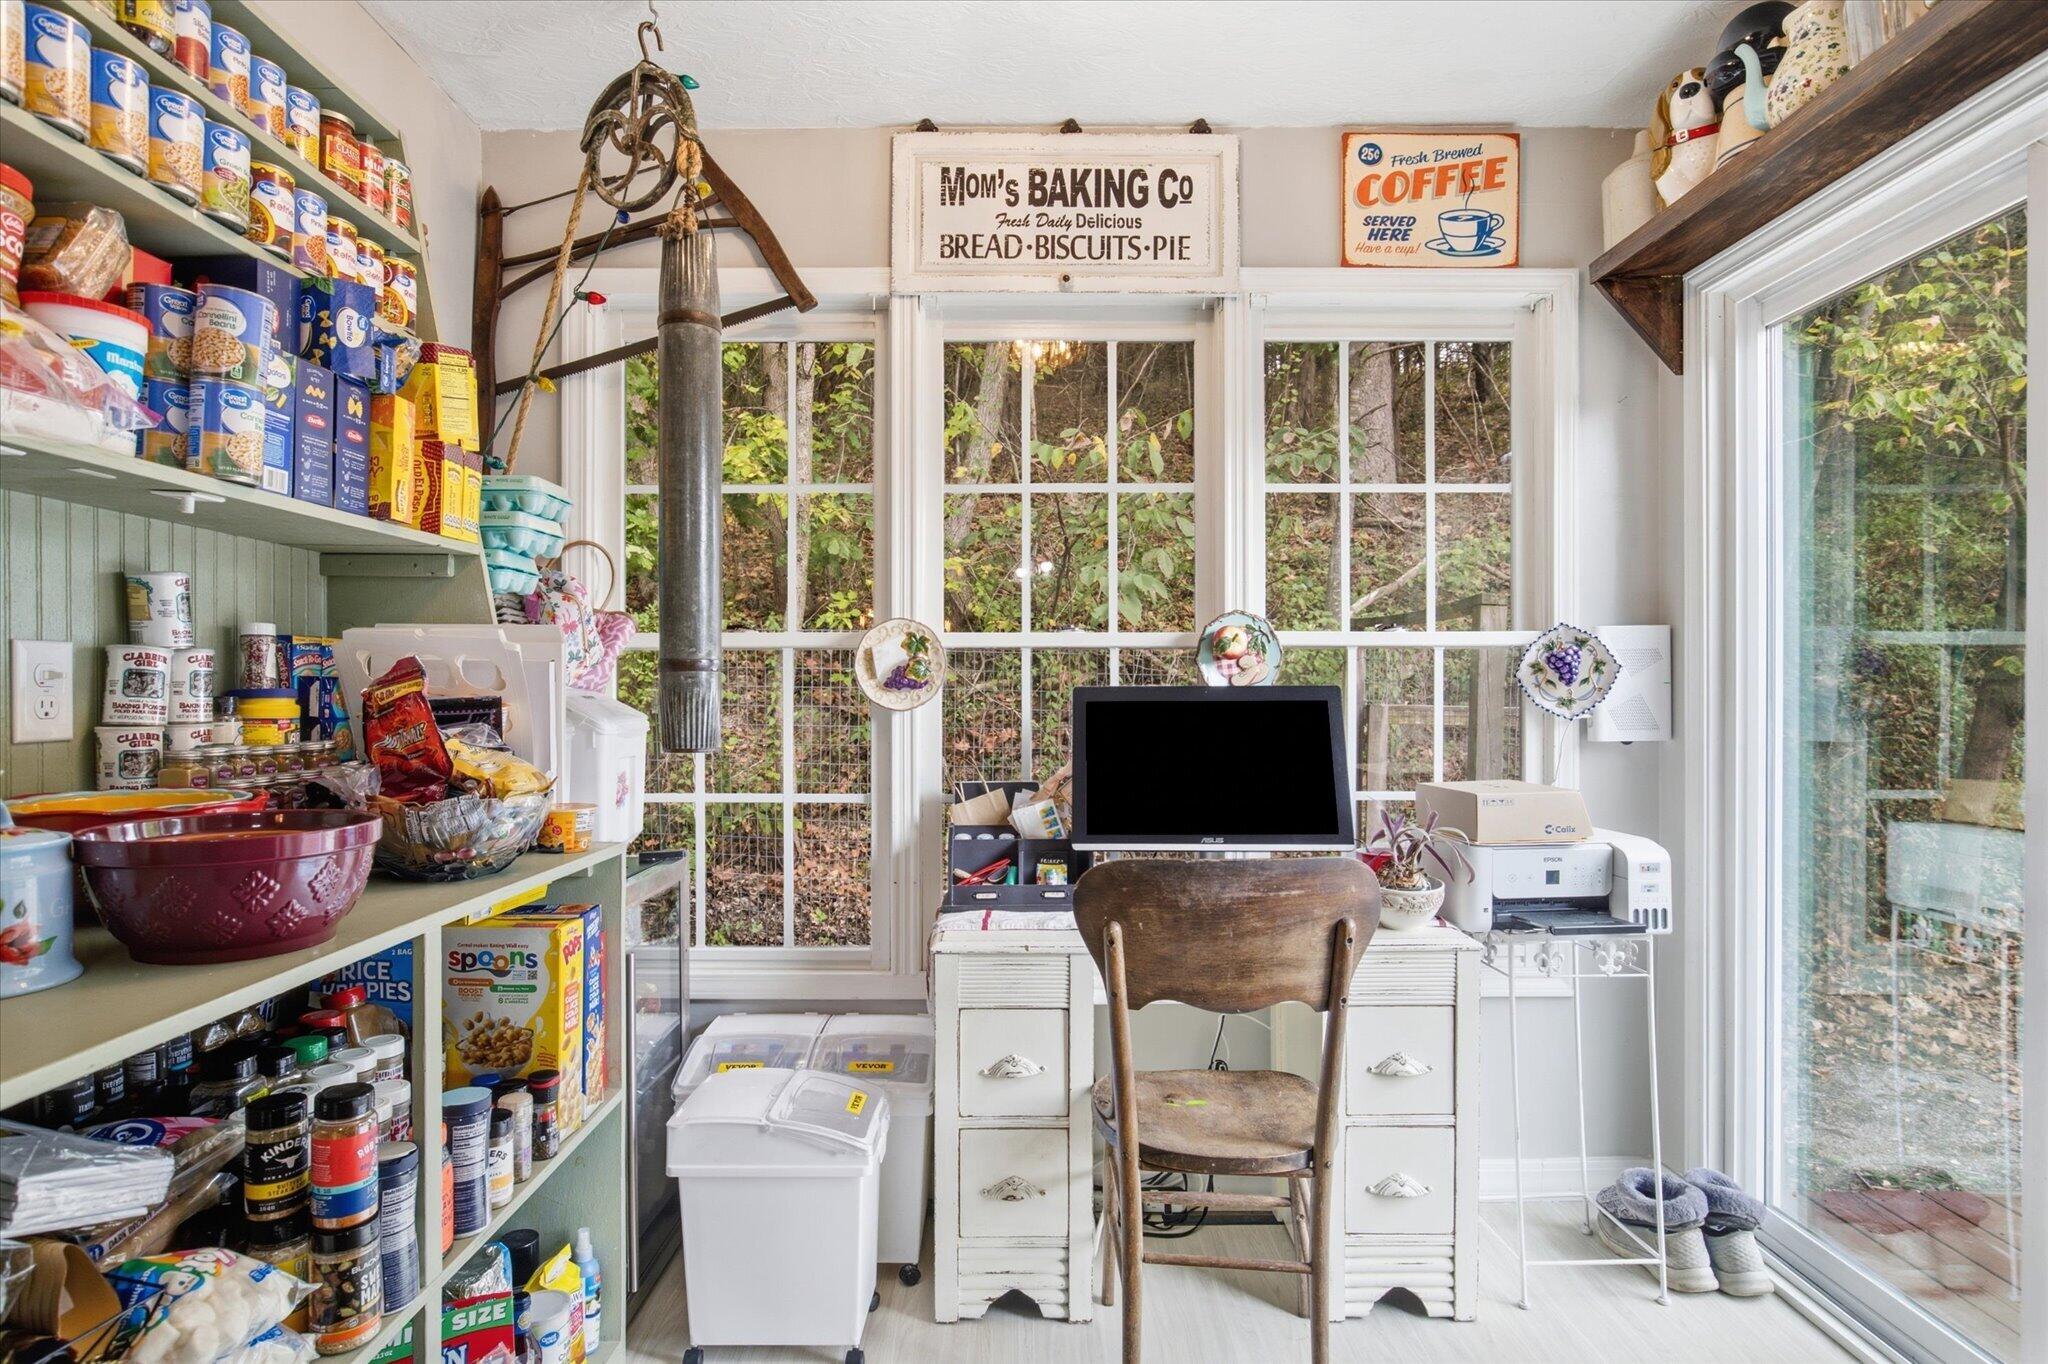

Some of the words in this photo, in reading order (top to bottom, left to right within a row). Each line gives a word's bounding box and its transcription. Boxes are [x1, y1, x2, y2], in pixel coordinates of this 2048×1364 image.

[1390, 152, 1430, 168] Fresh
[1433, 143, 1484, 163] Brewed
[1028, 168, 1149, 208] BAKING
[1355, 156, 1508, 208] COFFEE
[995, 212, 1031, 230] Fresh
[1036, 212, 1073, 232] Daily
[1076, 213, 1143, 229] Delicious
[1362, 215, 1417, 228] SERVED
[1367, 228, 1413, 242] HERE
[1355, 242, 1383, 254] Have
[1385, 246, 1393, 254] a
[1394, 242, 1422, 257] cup!
[209, 319, 236, 330] Beans
[123, 652, 168, 665] CLABBER
[448, 950, 538, 971] spoons
[341, 961, 391, 981] RICE
[107, 1226, 127, 1250] DARK
[452, 1302, 507, 1331] SIZE
